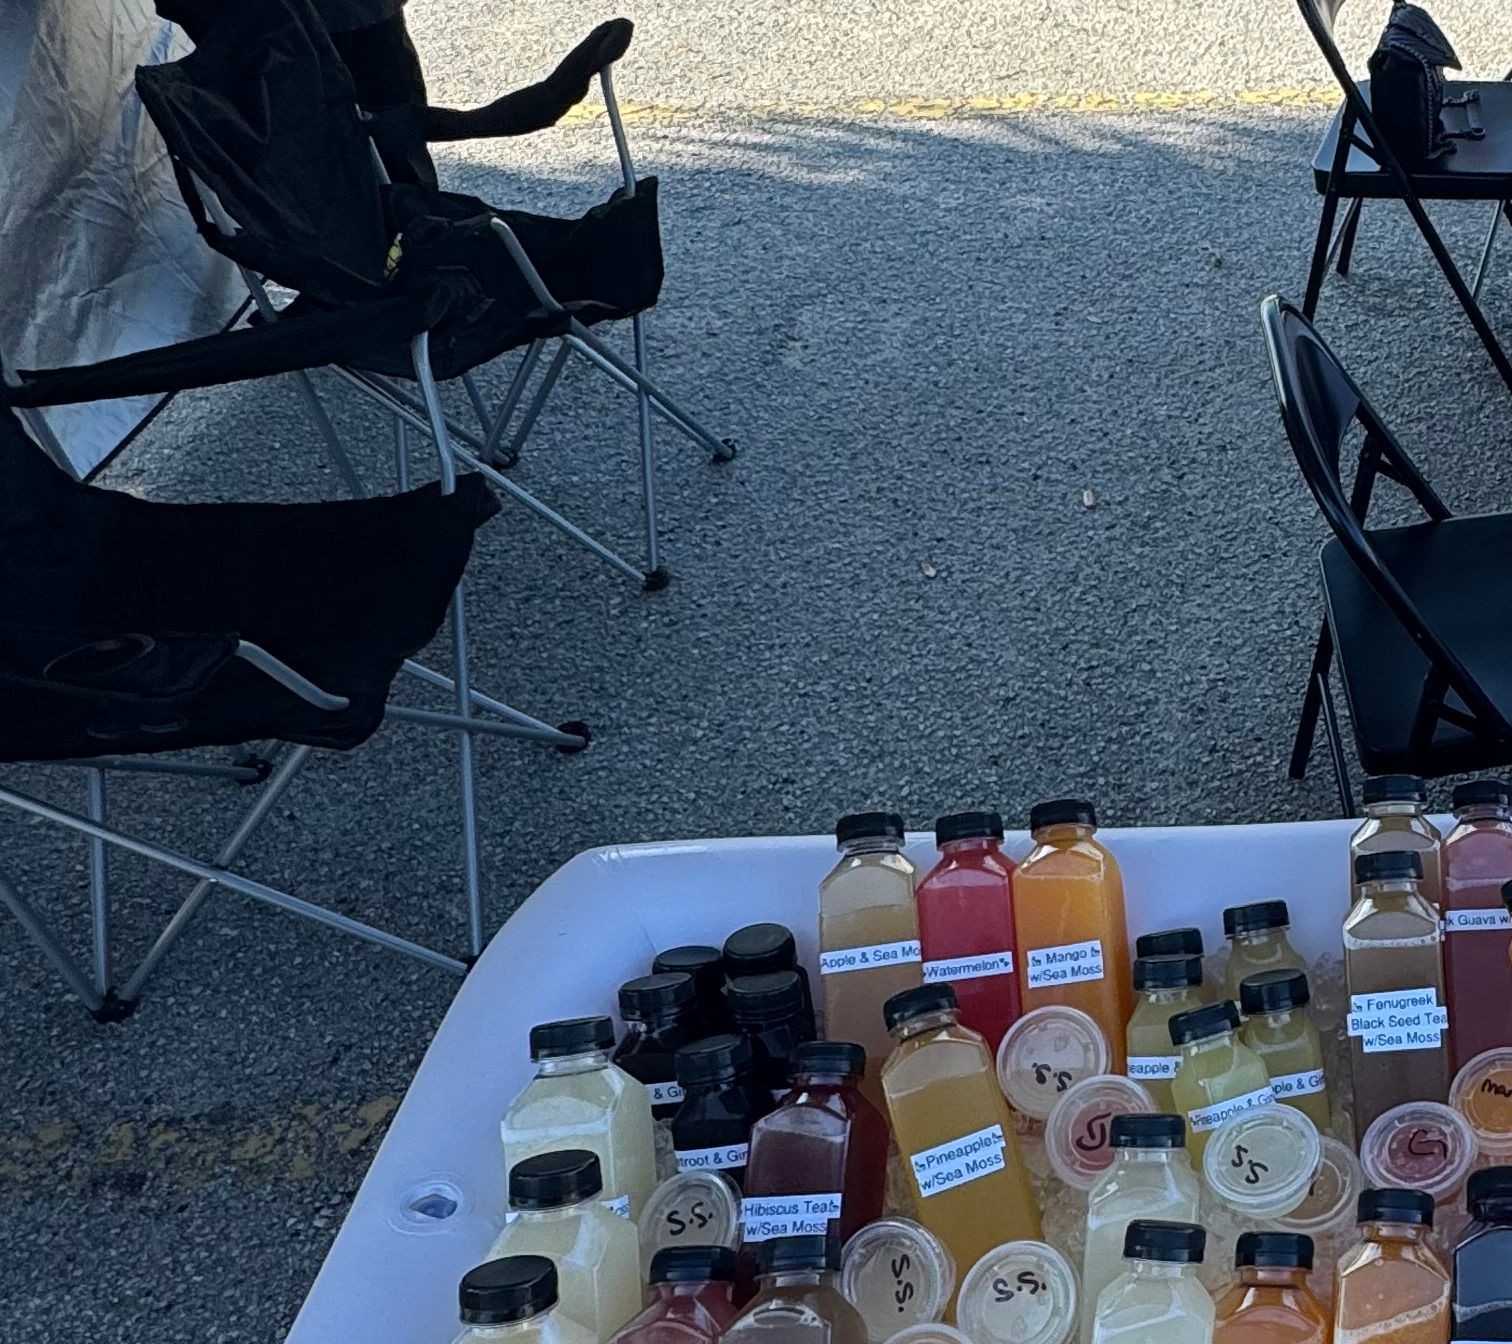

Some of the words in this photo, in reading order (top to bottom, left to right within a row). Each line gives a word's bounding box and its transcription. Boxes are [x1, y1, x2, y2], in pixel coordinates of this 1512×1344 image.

[1458, 914, 1497, 926] Guava
[821, 955, 856, 968] Apple
[860, 951, 869, 963] &
[873, 948, 898, 960] Sea
[1046, 949, 1087, 964] Mango
[926, 959, 999, 978] Watermelon
[1030, 968, 1067, 982] w/Sea
[1071, 963, 1102, 976] Moss
[1367, 994, 1433, 1012] Fenugreek
[1351, 1016, 1385, 1030] Black
[1388, 1013, 1421, 1026] Seed
[1424, 1012, 1447, 1025] Tea
[1364, 1033, 1403, 1047] w/Sea
[1407, 1031, 1440, 1044] Moss
[926, 1136, 992, 1169] Pineapple
[922, 1165, 963, 1191] w/Sea
[965, 1153, 1002, 1176] Moss
[744, 1201, 799, 1217] Hibiscus
[804, 1201, 831, 1214] Tea
[746, 1222, 788, 1236] w/Sea
[792, 1220, 827, 1234] Moss
